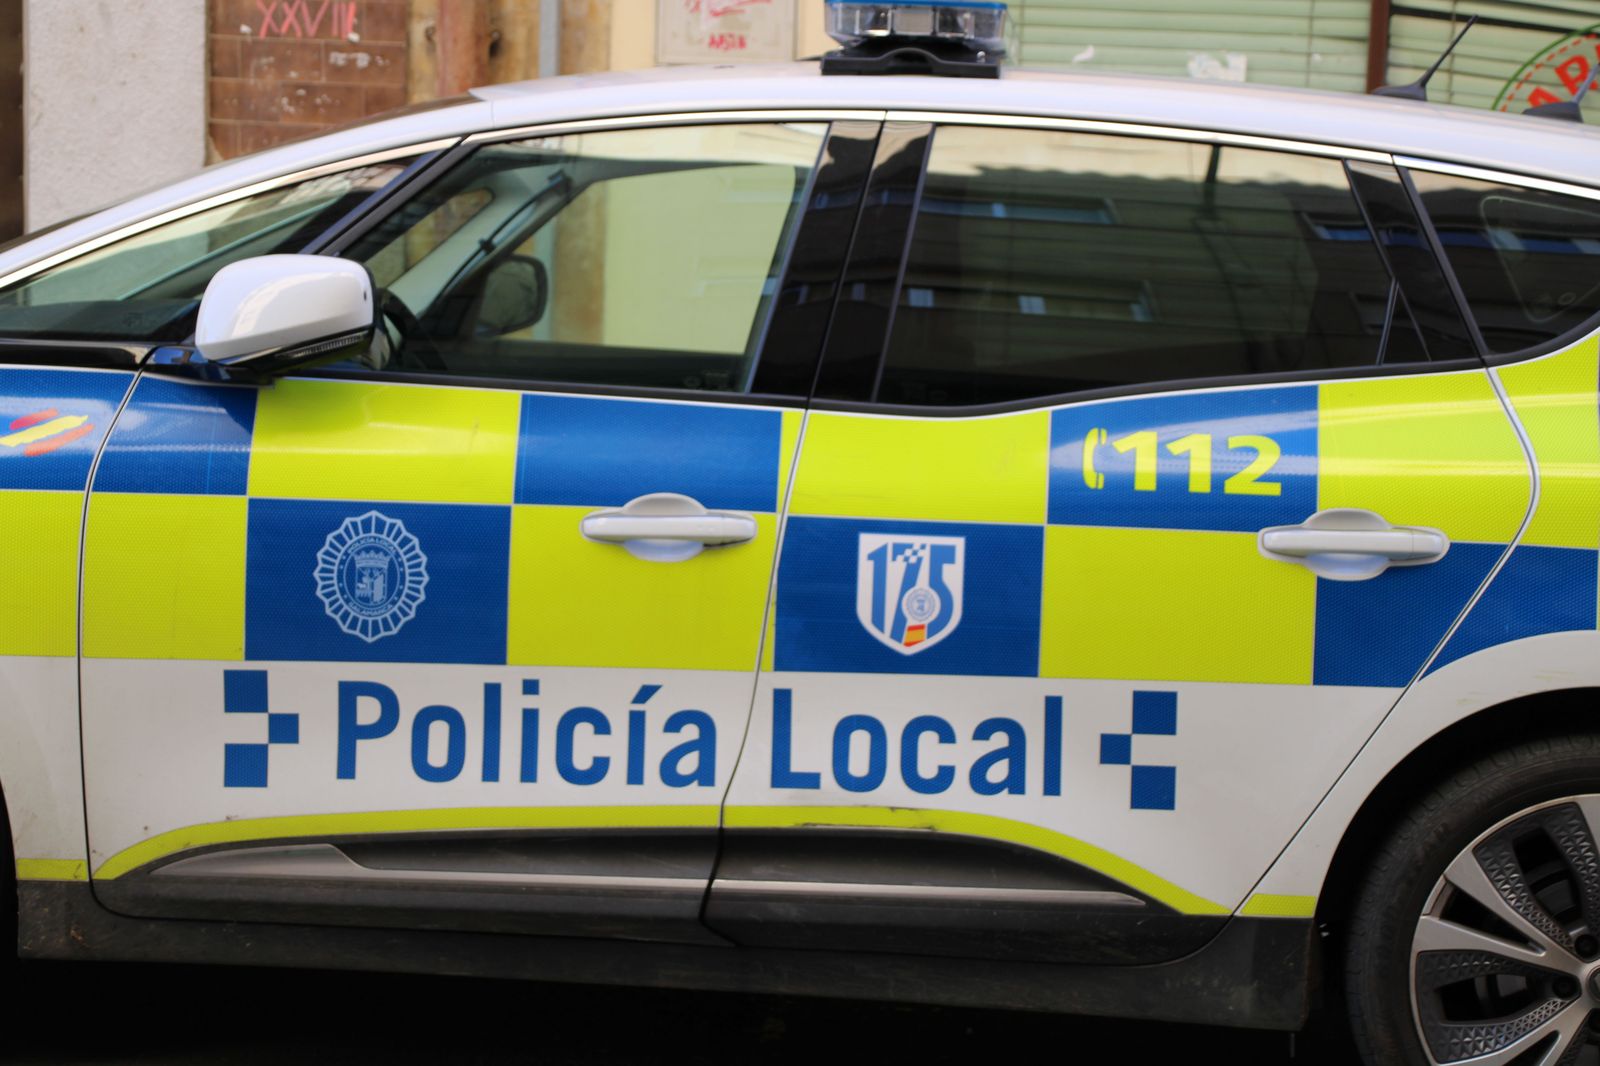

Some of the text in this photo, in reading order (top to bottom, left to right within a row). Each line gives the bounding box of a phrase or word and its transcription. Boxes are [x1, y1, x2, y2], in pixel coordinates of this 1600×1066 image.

[1112, 430, 1282, 497] 112
[867, 542, 956, 643] 175
[336, 679, 1063, 797] Policía Local
